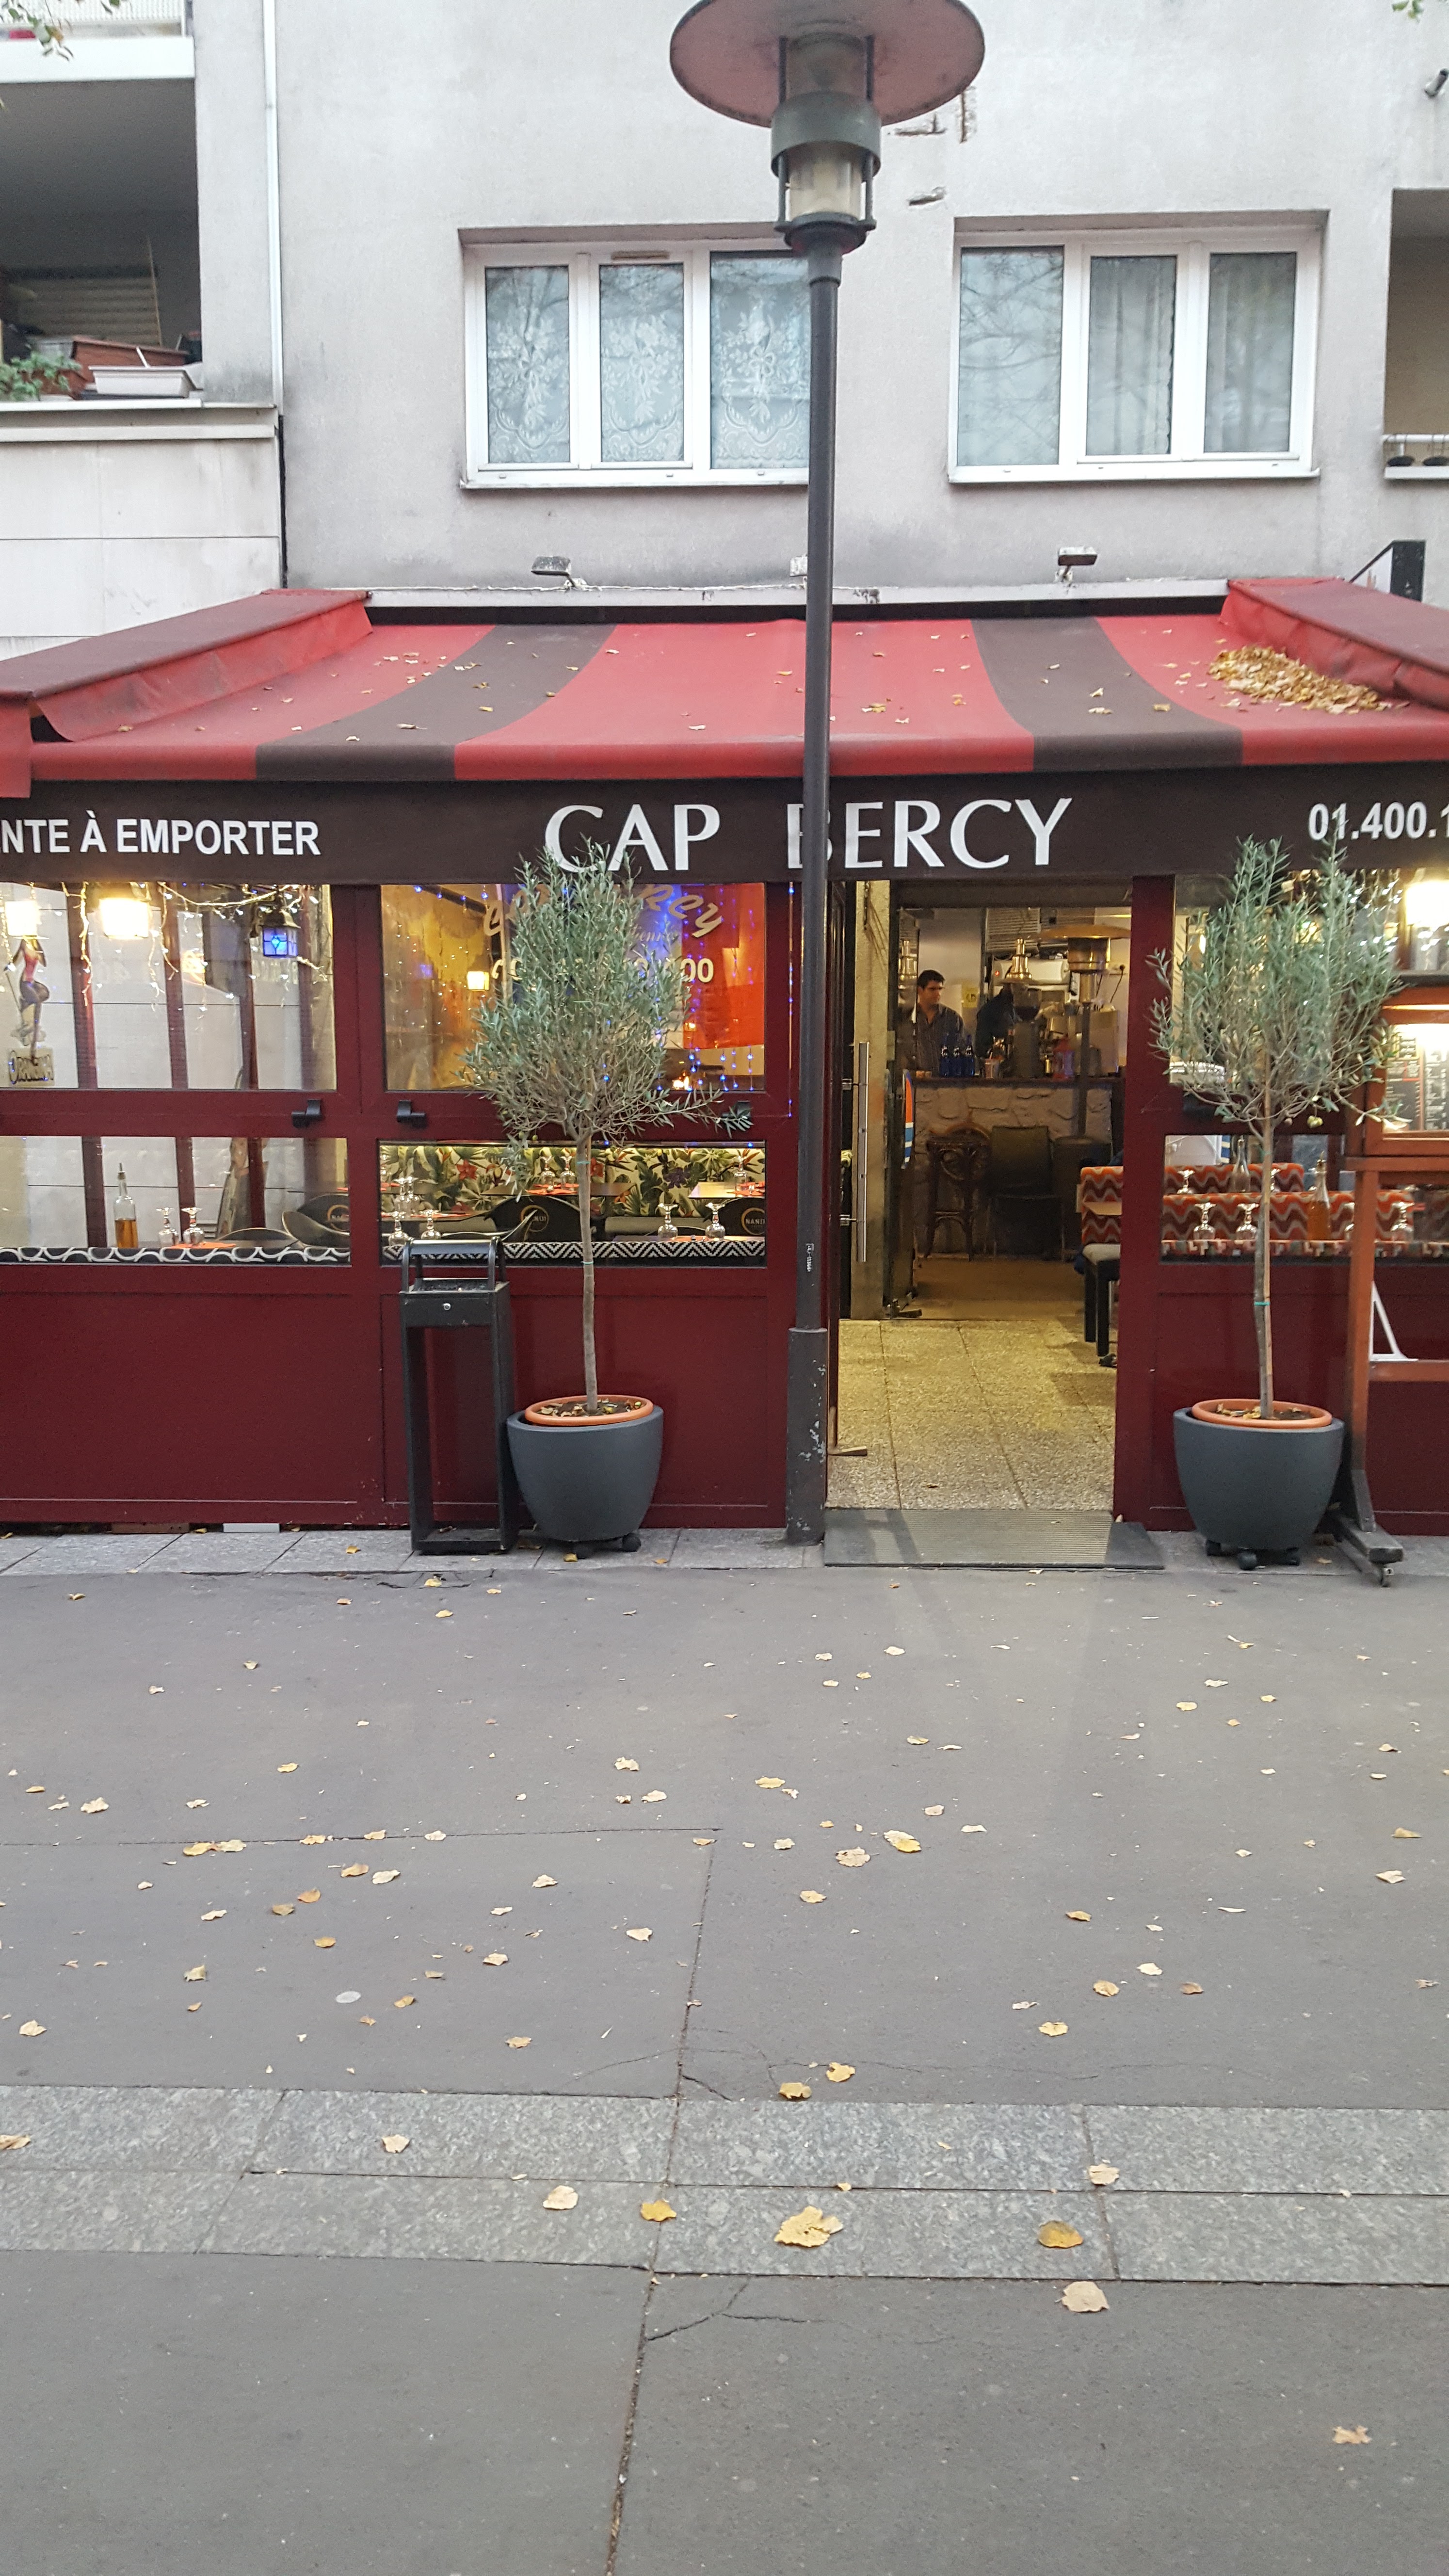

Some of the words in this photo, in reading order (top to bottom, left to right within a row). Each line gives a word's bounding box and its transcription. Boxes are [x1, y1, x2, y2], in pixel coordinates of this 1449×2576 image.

[0, 819, 70, 853] NTE
[80, 810, 108, 853] À
[116, 818, 322, 855] EMPORTER
[545, 804, 721, 873] CAP
